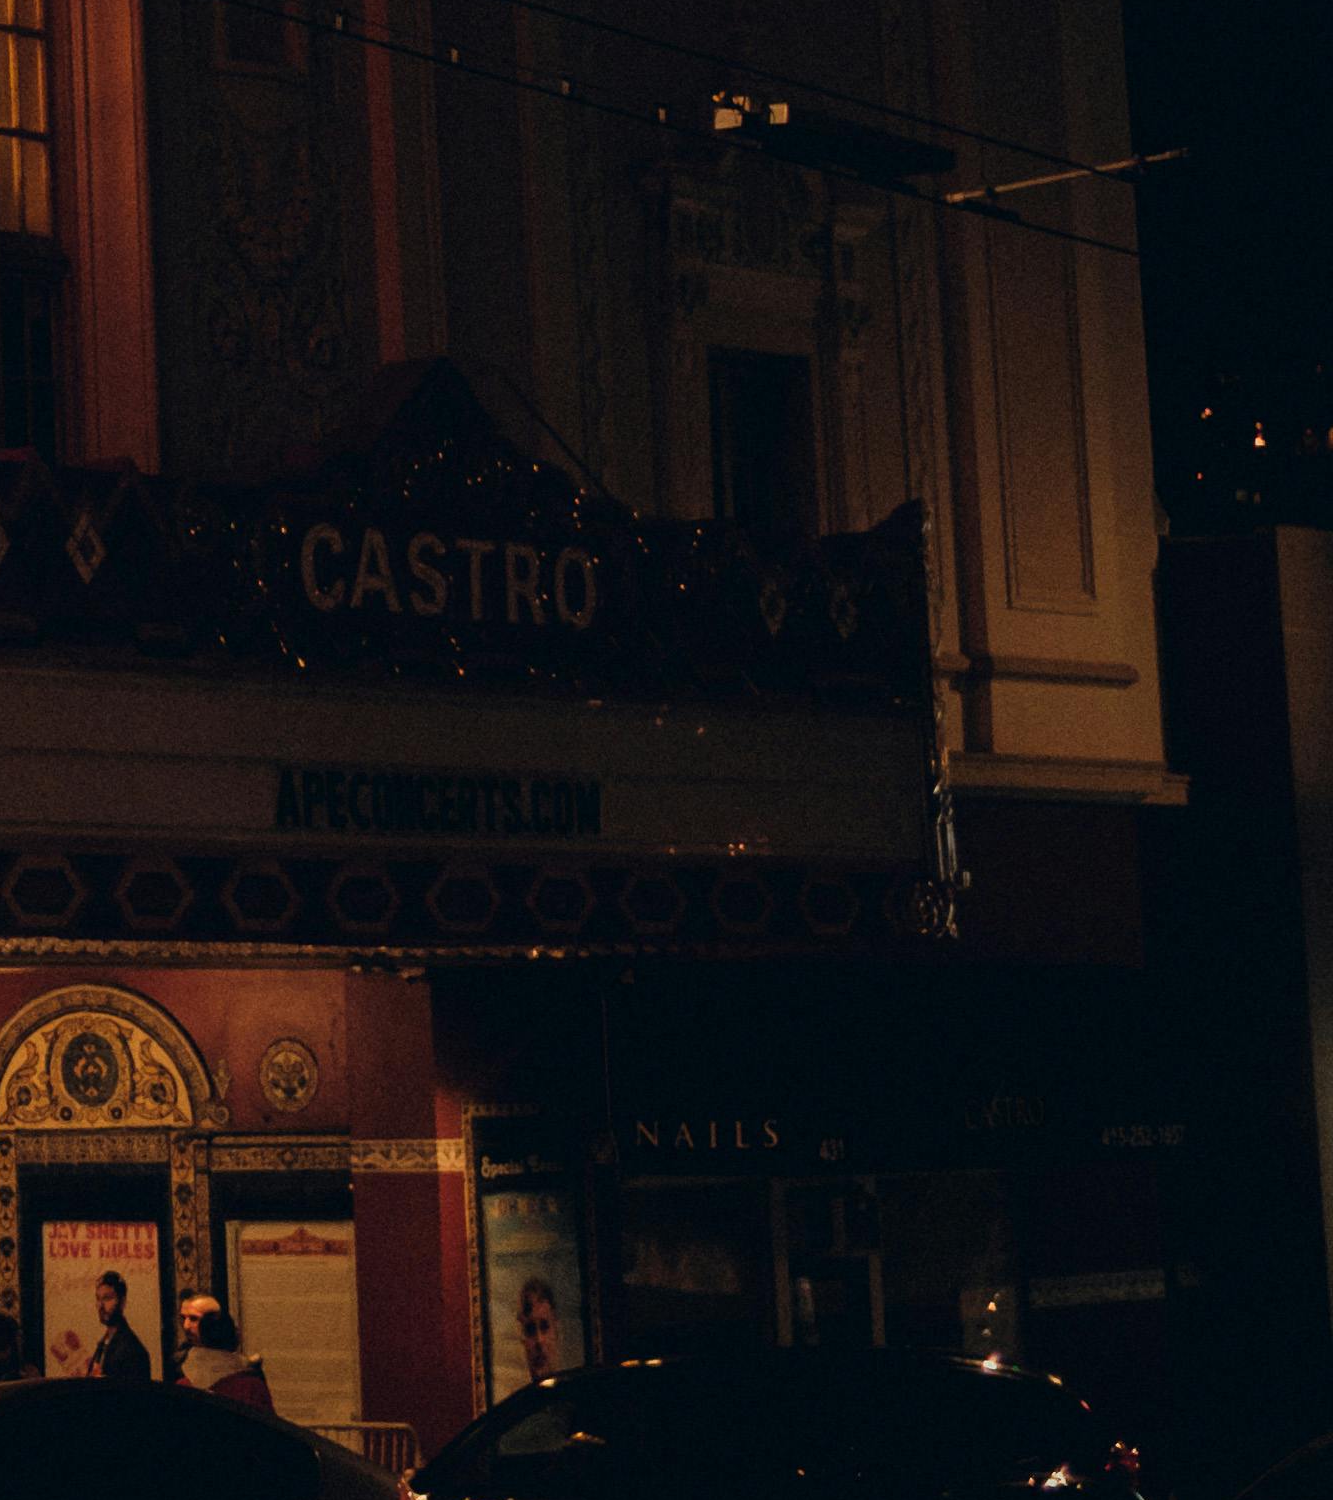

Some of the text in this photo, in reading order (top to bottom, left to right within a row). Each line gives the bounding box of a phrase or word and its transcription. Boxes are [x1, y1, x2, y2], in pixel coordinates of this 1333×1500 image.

[300, 522, 597, 629] CASTRO
[277, 769, 601, 834] APECONCERTS.COM
[636, 1118, 781, 1151] NAILS
[48, 1241, 91, 1258] LOVE
